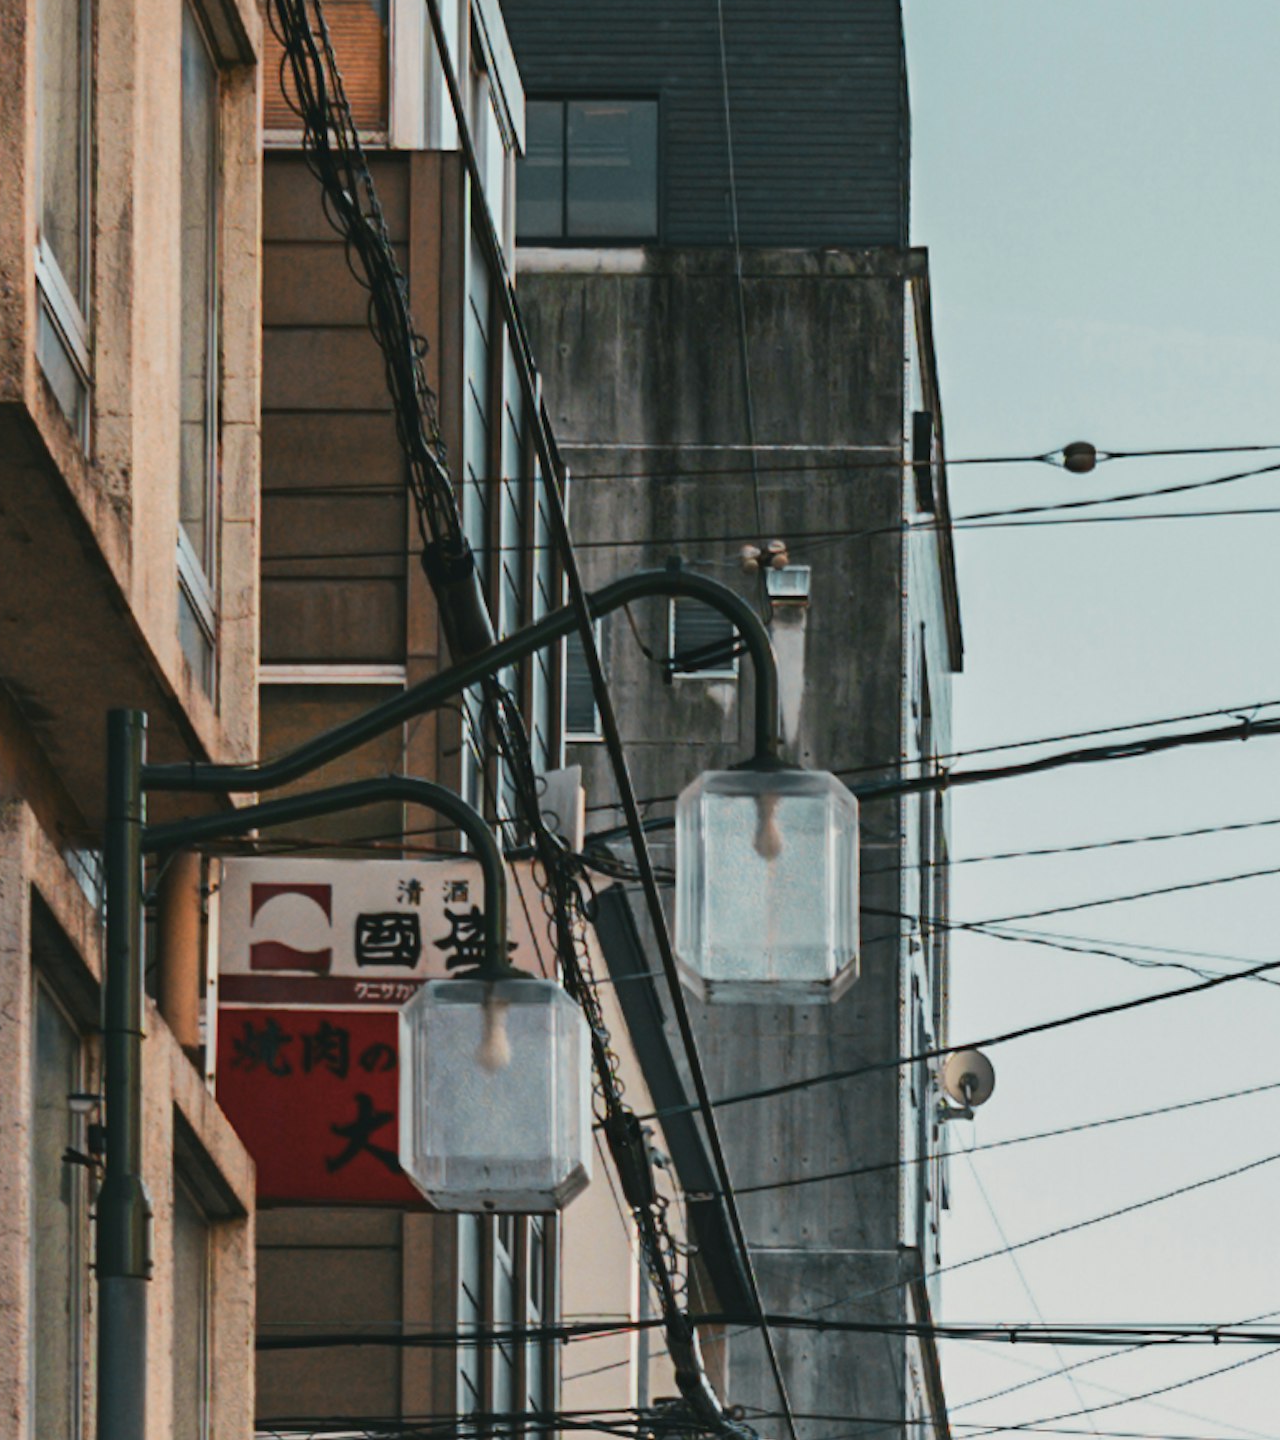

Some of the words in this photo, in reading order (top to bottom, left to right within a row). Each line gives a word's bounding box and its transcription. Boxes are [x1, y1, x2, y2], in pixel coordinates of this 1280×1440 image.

[397, 879, 469, 905] 清酒
[233, 1018, 396, 1078] 焼肉の
